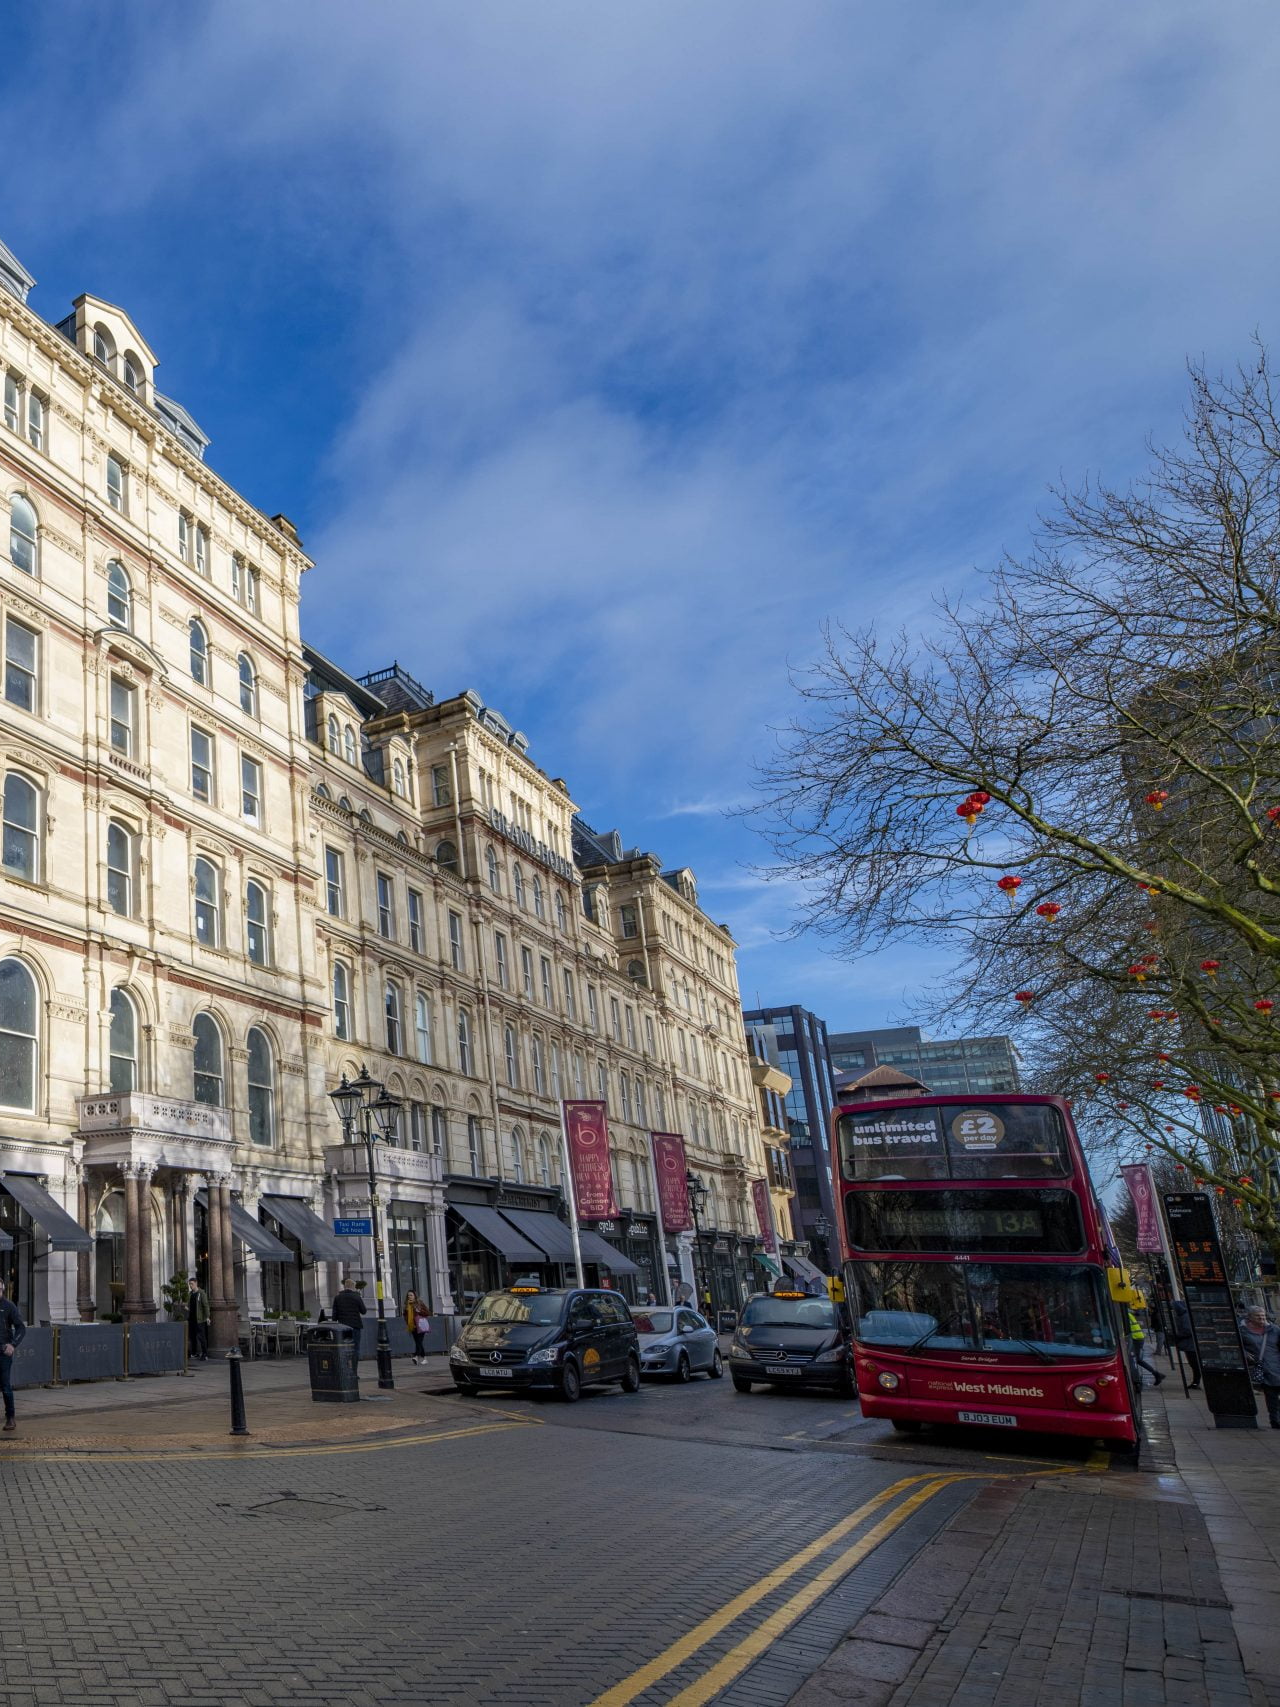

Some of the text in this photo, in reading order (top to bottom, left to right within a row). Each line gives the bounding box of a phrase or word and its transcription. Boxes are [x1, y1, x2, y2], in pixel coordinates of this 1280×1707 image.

[854, 1120, 936, 1134] unlimited
[960, 1117, 997, 1134] £2
[852, 1132, 938, 1146] bus travel
[963, 1134, 997, 1143] per day
[580, 1154, 599, 1162] HAPPY
[598, 1219, 615, 1233] cycle
[953, 1381, 985, 1394] West
[987, 1384, 1045, 1397] Midlands
[963, 1413, 1013, 1425] BJ03 EUM
